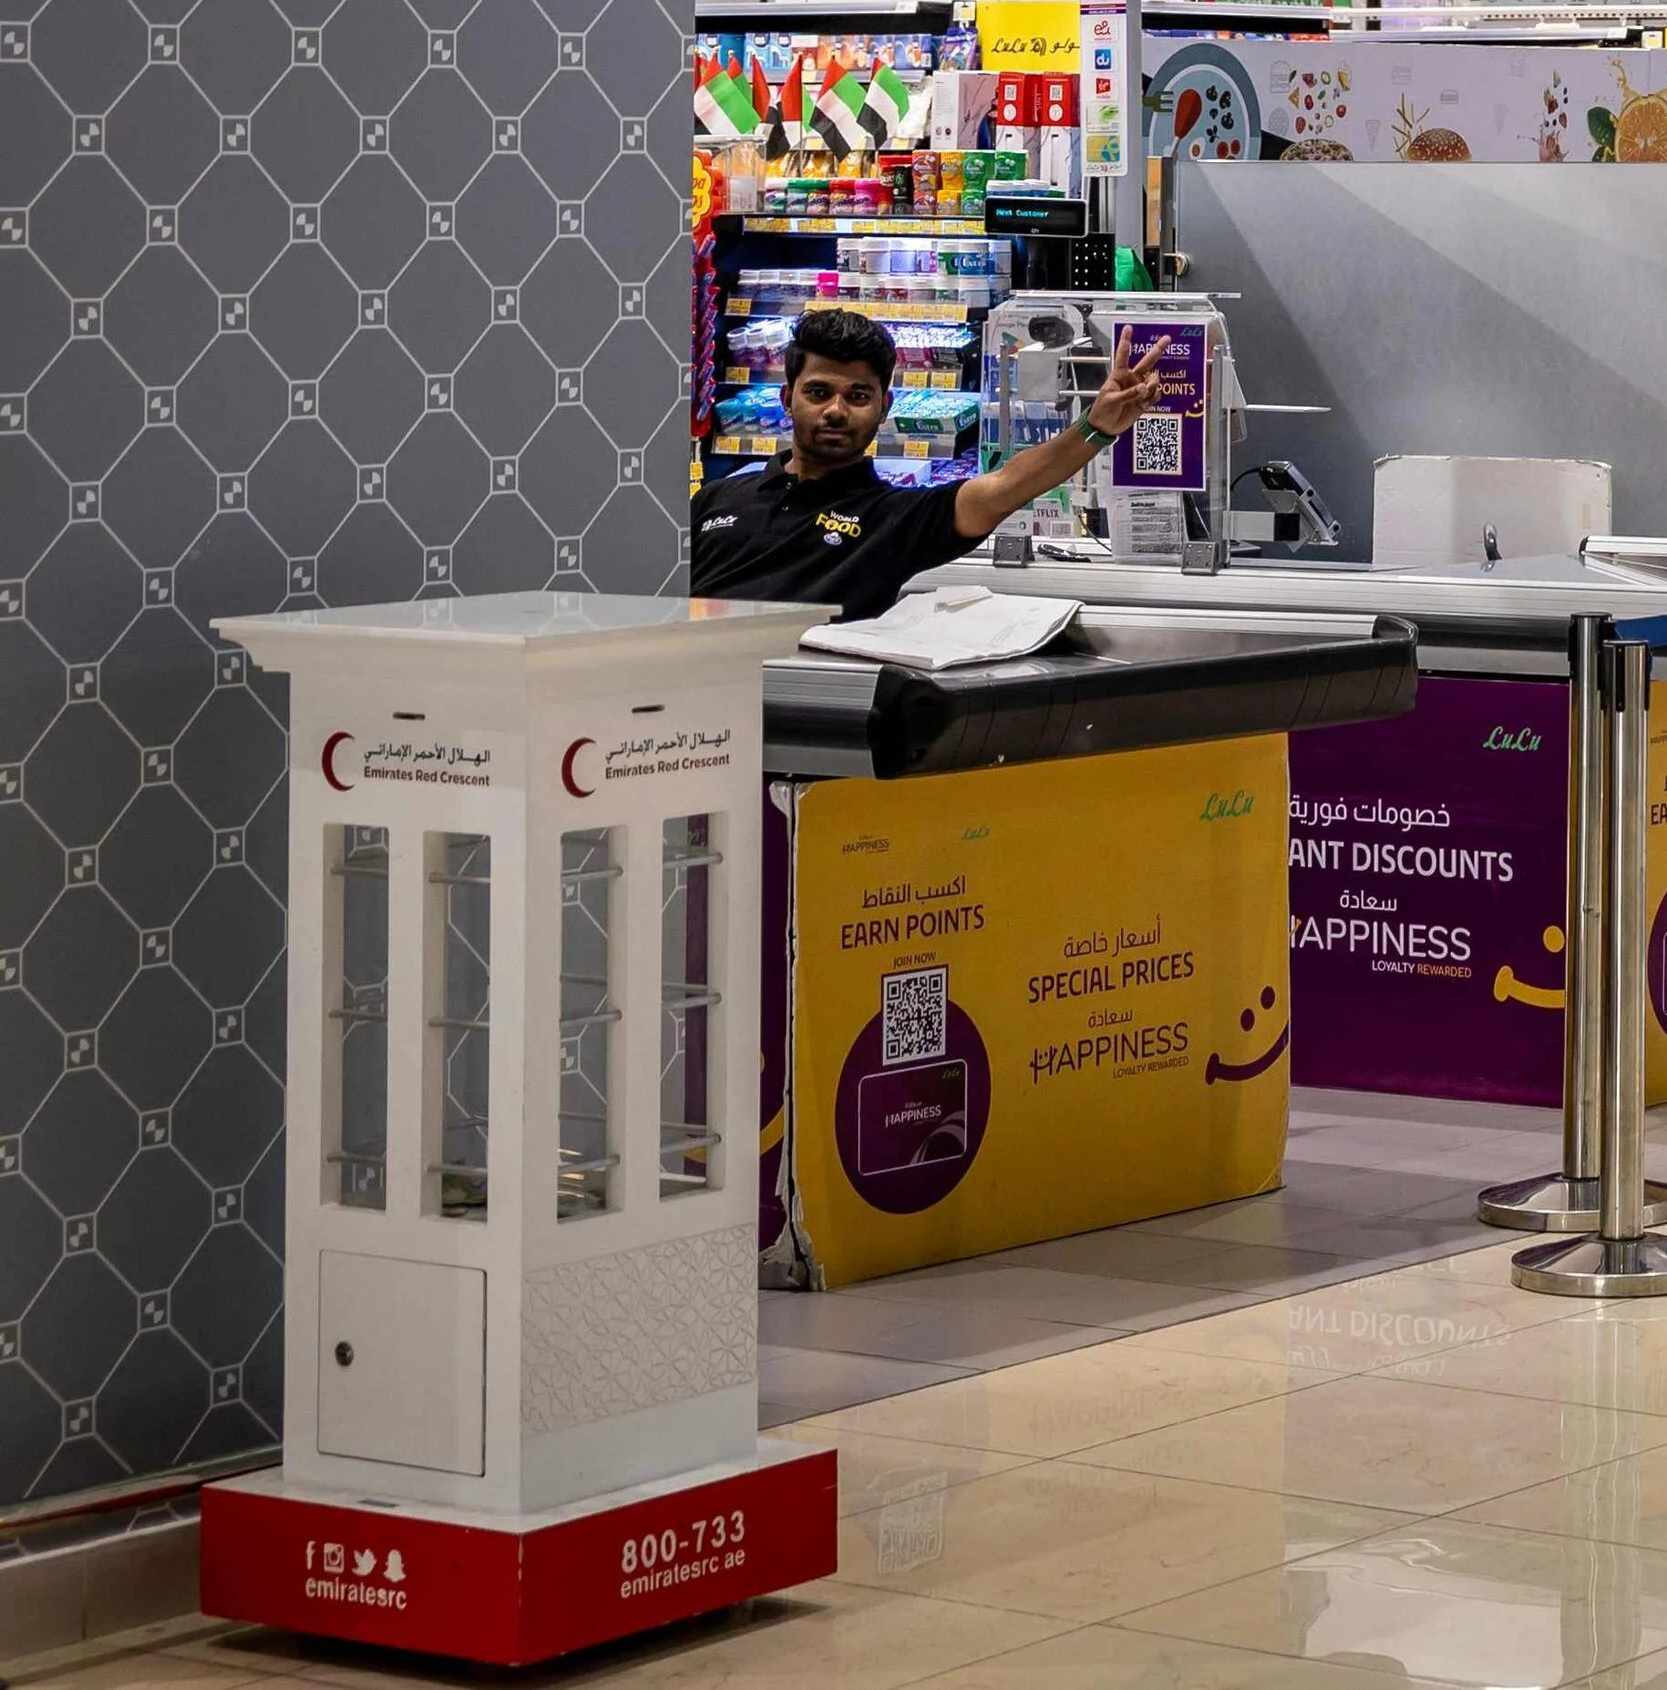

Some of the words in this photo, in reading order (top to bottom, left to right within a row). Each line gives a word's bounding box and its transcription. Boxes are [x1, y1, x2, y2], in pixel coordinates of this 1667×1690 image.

[1158, 383, 1195, 396] POINTS
[815, 513, 861, 538] FOOD
[830, 510, 859, 523] WORLD
[605, 738, 654, 764] الإماراتي
[655, 731, 688, 755] الأحمر
[689, 728, 731, 750] الهلال
[1482, 726, 1542, 752] LuLu
[364, 742, 412, 763] الإماراتي
[414, 742, 446, 762] الأحمر
[448, 747, 491, 767] الهلال
[364, 766, 413, 782] Emirates
[416, 769, 438, 782] Red
[440, 771, 490, 787] Crescent
[605, 763, 655, 780] Emirates
[657, 759, 679, 773] Red
[682, 753, 730, 770] Crescent
[1199, 790, 1254, 821] LuLu
[1288, 794, 1348, 827] فورية
[1353, 798, 1451, 832] خصومات
[842, 838, 890, 855] HAPPINESS
[1352, 842, 1513, 882] DISCOUNTS
[861, 884, 911, 909] النقاط
[915, 875, 966, 905] اكسب
[1340, 889, 1397, 912] سعادة
[841, 916, 900, 950] EARN
[906, 904, 985, 940] POINTS
[1112, 913, 1161, 958] أسعار
[1063, 930, 1108, 958] خاصة
[893, 954, 913, 970] JOIN
[914, 951, 937, 966] NOW
[1372, 960, 1415, 974] LOYALTY
[1417, 964, 1472, 979] REWARDED
[1028, 964, 1116, 1004] SPECIAL
[1122, 951, 1195, 988] PRICES
[1088, 1007, 1134, 1028] سعادة
[1030, 1022, 1189, 1085] HAPPINESS
[1112, 1063, 1146, 1079] LOYALTY
[1147, 1056, 1189, 1073] REWARDED
[885, 1105, 942, 1128] HAPPINESS
[621, 1510, 745, 1574] 800-733
[305, 1576, 407, 1610] emiratesrc
